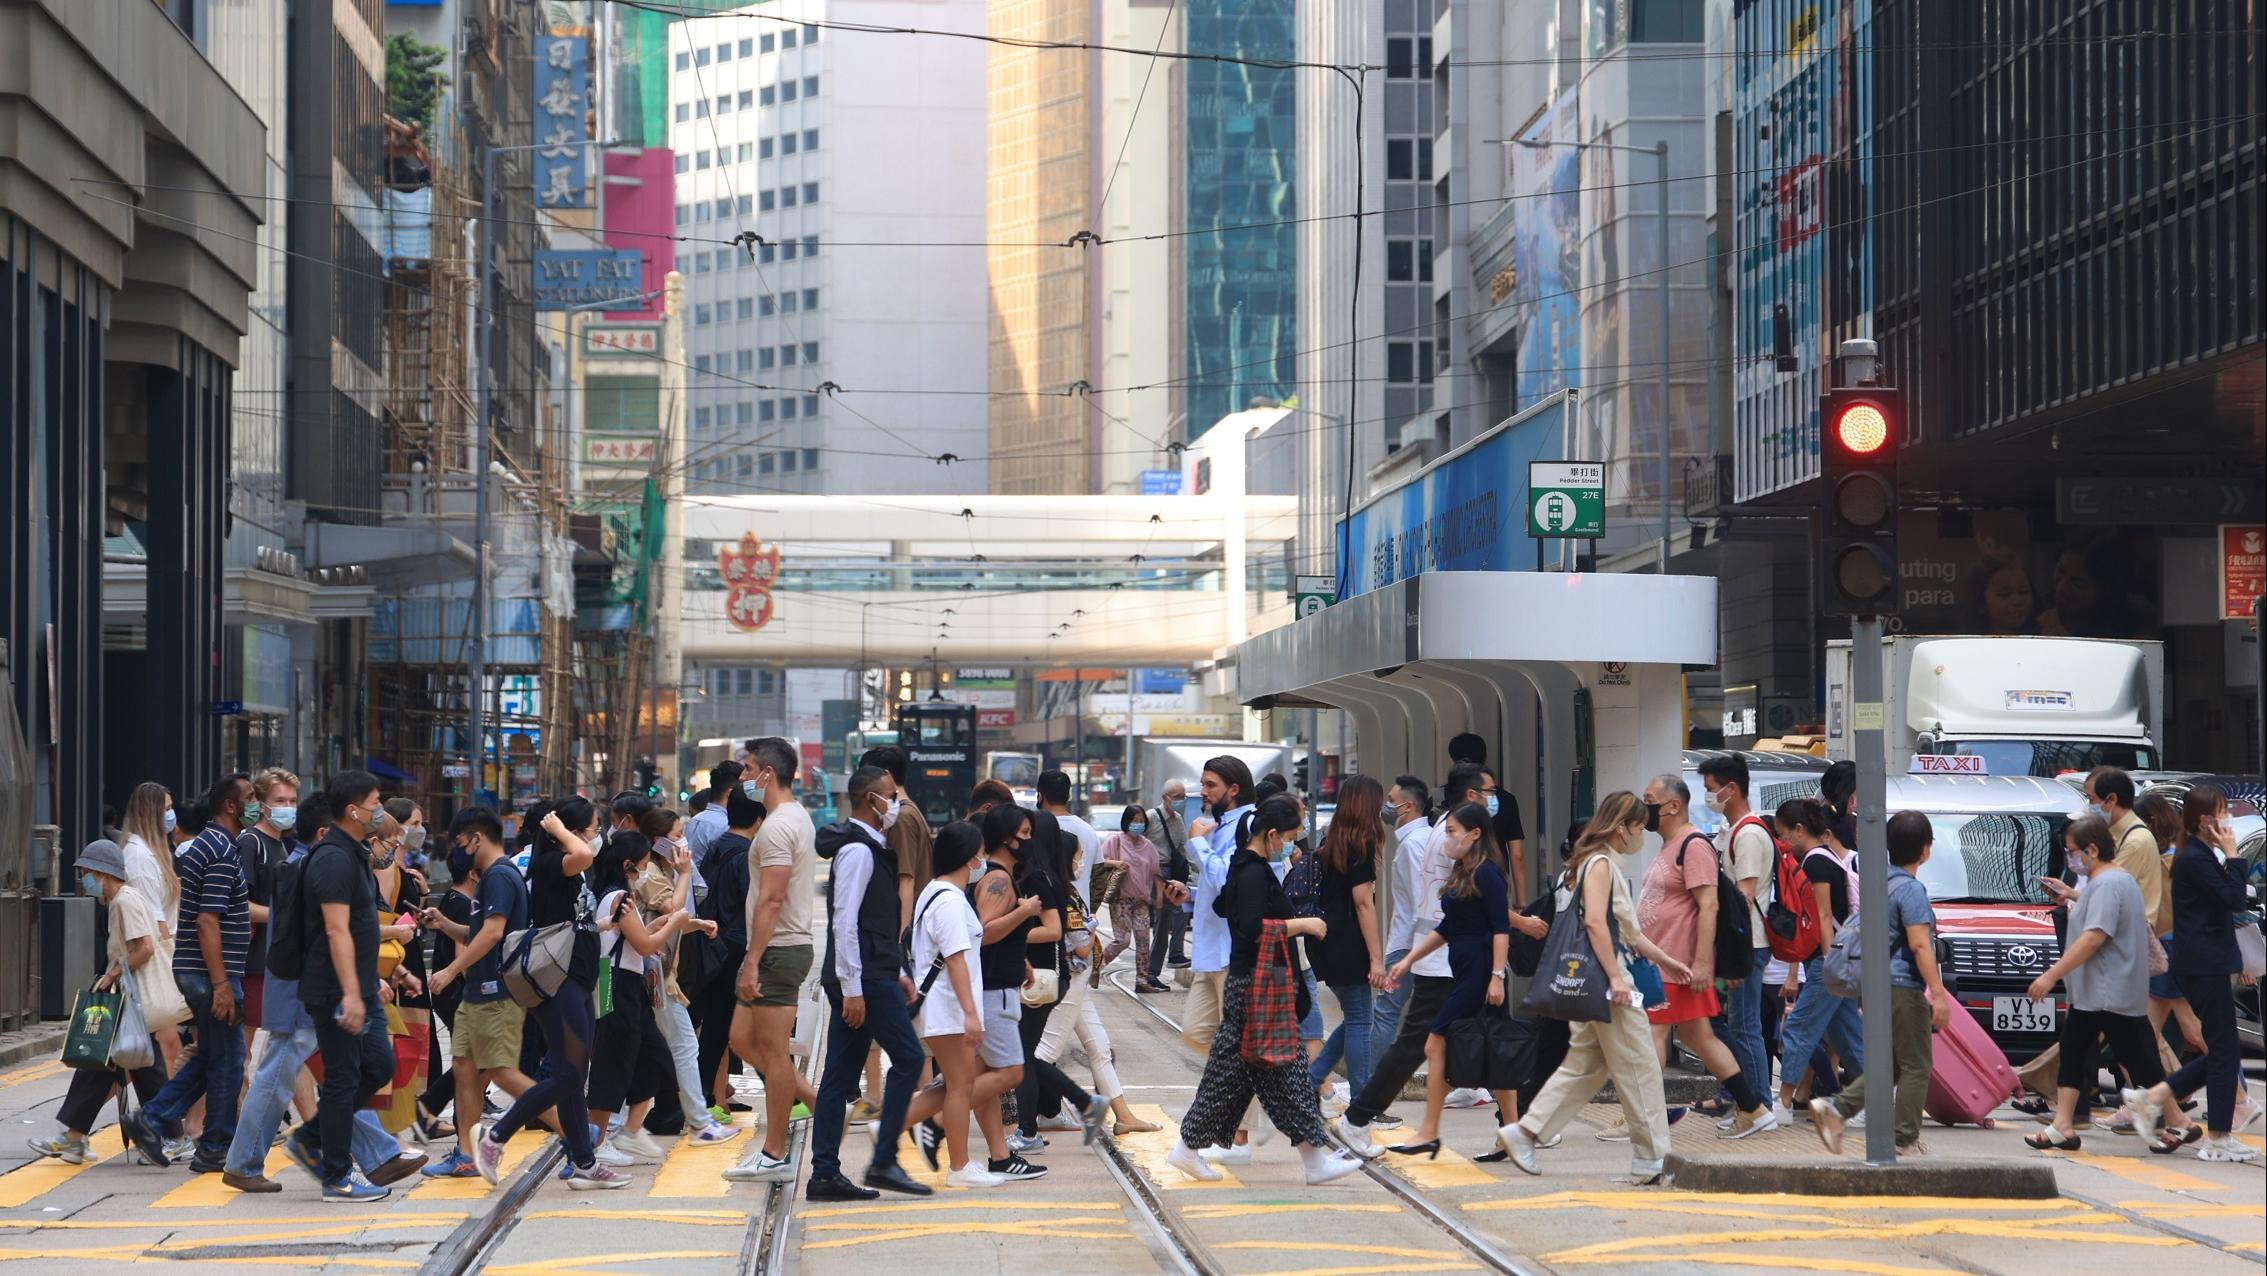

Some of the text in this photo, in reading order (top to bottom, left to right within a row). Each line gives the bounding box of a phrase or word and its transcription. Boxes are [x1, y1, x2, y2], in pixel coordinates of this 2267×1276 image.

[539, 39, 580, 203] 日發文具
[1570, 467, 1599, 477] 畢打街
[1582, 491, 1599, 499] 27E
[1904, 589, 1955, 609] para
[978, 713, 1008, 726] KFC
[909, 751, 967, 763] Panasonic
[1917, 756, 1981, 771] TAXI
[1555, 974, 1586, 988] SNOOPY
[2011, 998, 2035, 1014] VY
[1997, 1014, 2051, 1030] 8539
